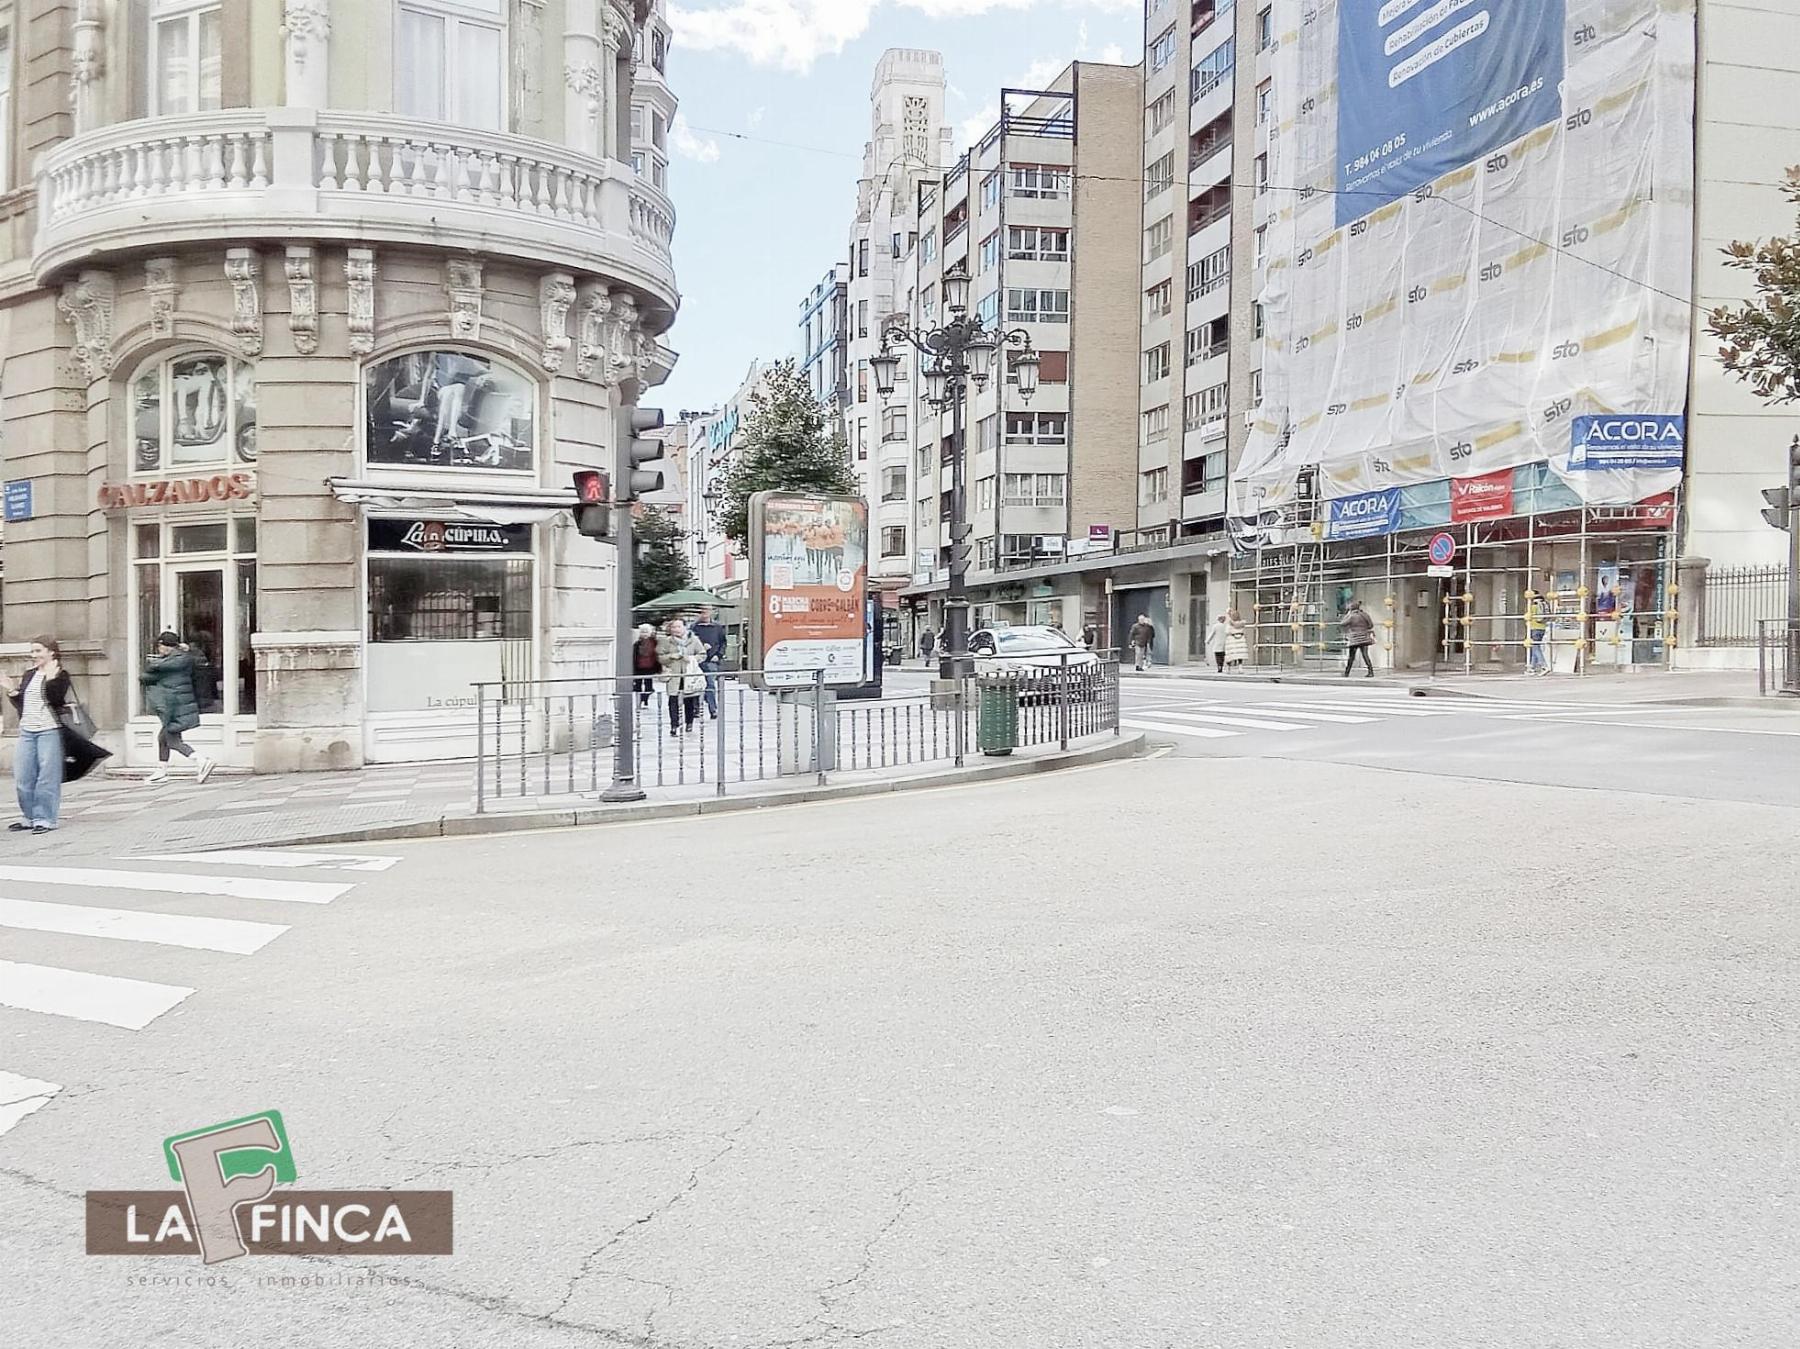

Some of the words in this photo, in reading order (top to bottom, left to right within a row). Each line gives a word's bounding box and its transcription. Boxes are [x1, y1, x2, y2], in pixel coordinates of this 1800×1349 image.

[1573, 24, 1596, 46] sto
[1393, 50, 1433, 81] Renovación
[1444, 20, 1484, 50] Cubiertas
[1468, 77, 1544, 127] www.acora.es
[1566, 107, 1592, 131] sto
[1394, 132, 1407, 148] 05
[1486, 151, 1508, 175] sto
[1415, 185, 1433, 204] sto
[1350, 219, 1367, 237] sto
[1562, 224, 1589, 248] sto
[1298, 248, 1313, 267] sto
[1480, 261, 1502, 282] sto
[1408, 284, 1427, 304] sto
[1346, 313, 1363, 331] sto
[1552, 339, 1580, 361] sto
[1543, 398, 1572, 423] sto
[1450, 441, 1473, 461] sto
[97, 473, 252, 508] CALZADOS
[1339, 495, 1389, 519] ACORA
[401, 521, 424, 550] La
[426, 696, 442, 707] La
